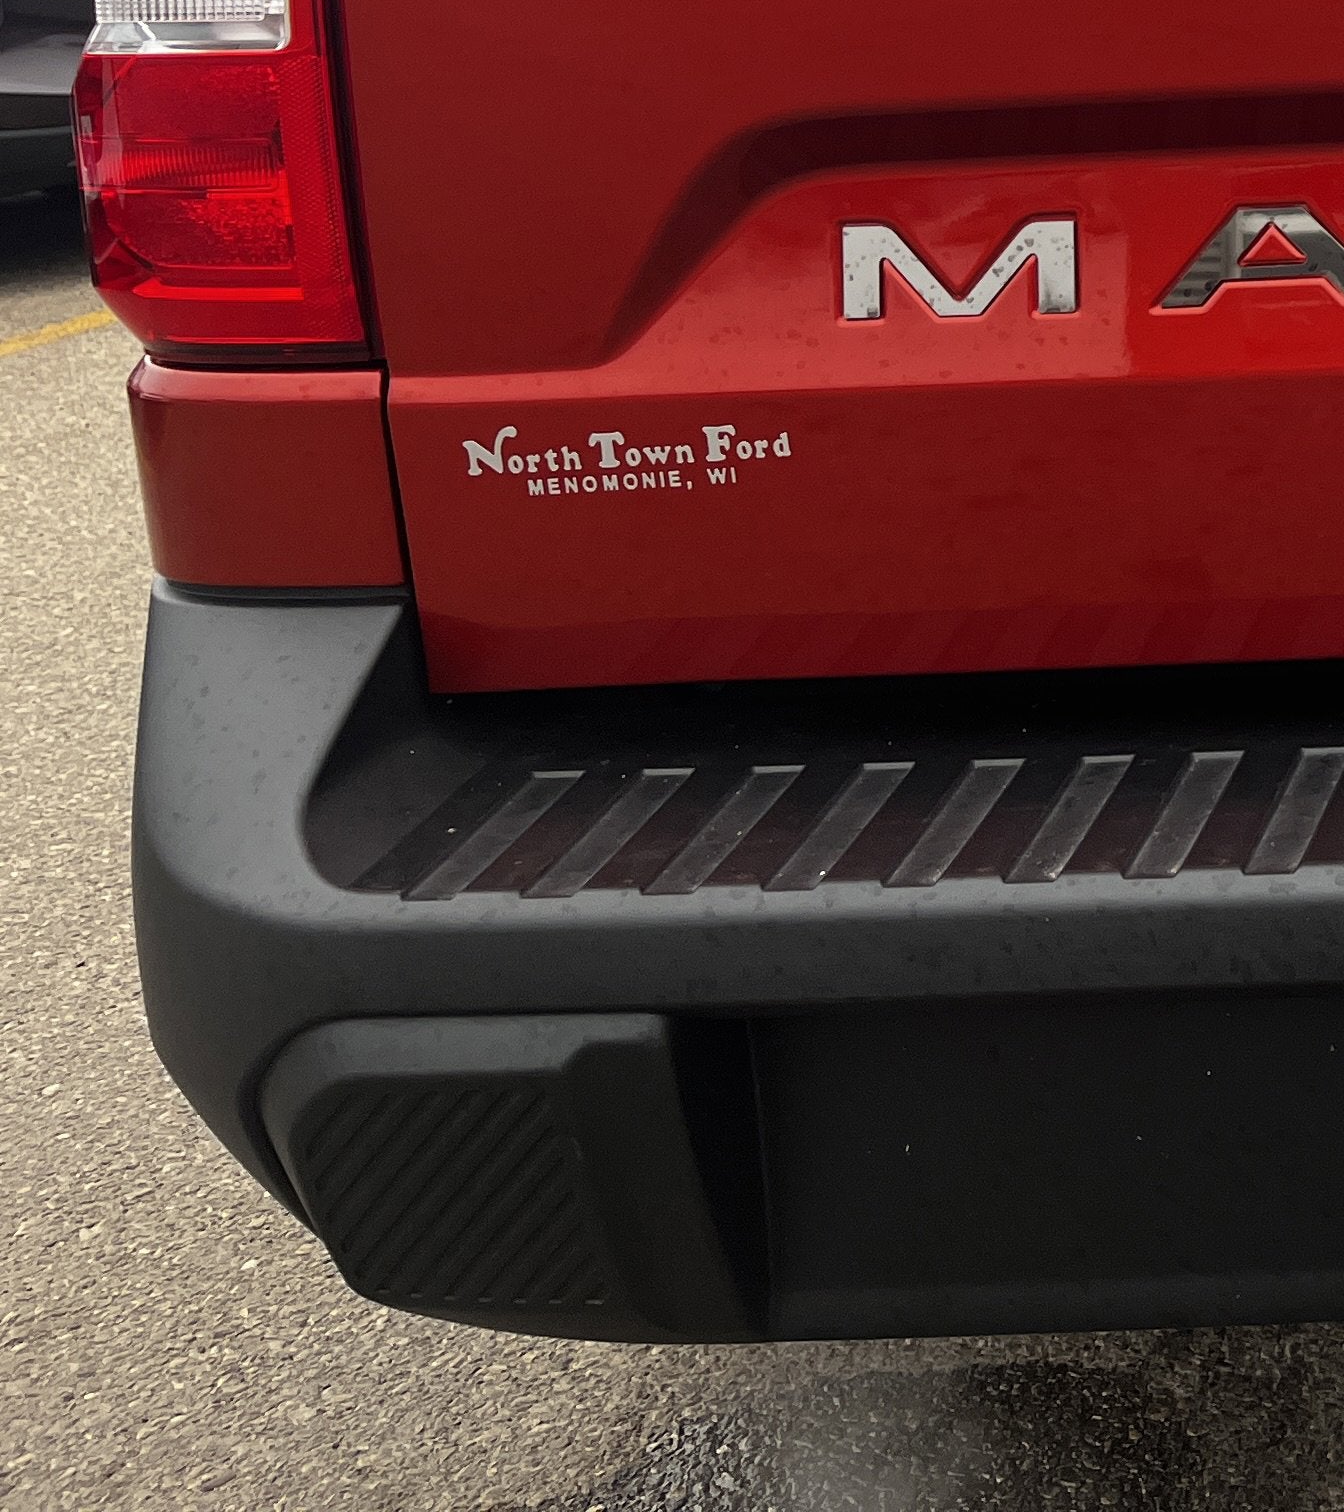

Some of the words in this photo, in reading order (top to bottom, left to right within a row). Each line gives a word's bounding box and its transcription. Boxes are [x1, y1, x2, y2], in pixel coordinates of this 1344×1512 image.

[462, 426, 582, 476] North
[588, 431, 695, 468] Town
[702, 424, 792, 462] Ford
[527, 469, 694, 496] MENOMONIE,
[706, 467, 738, 485] WI
